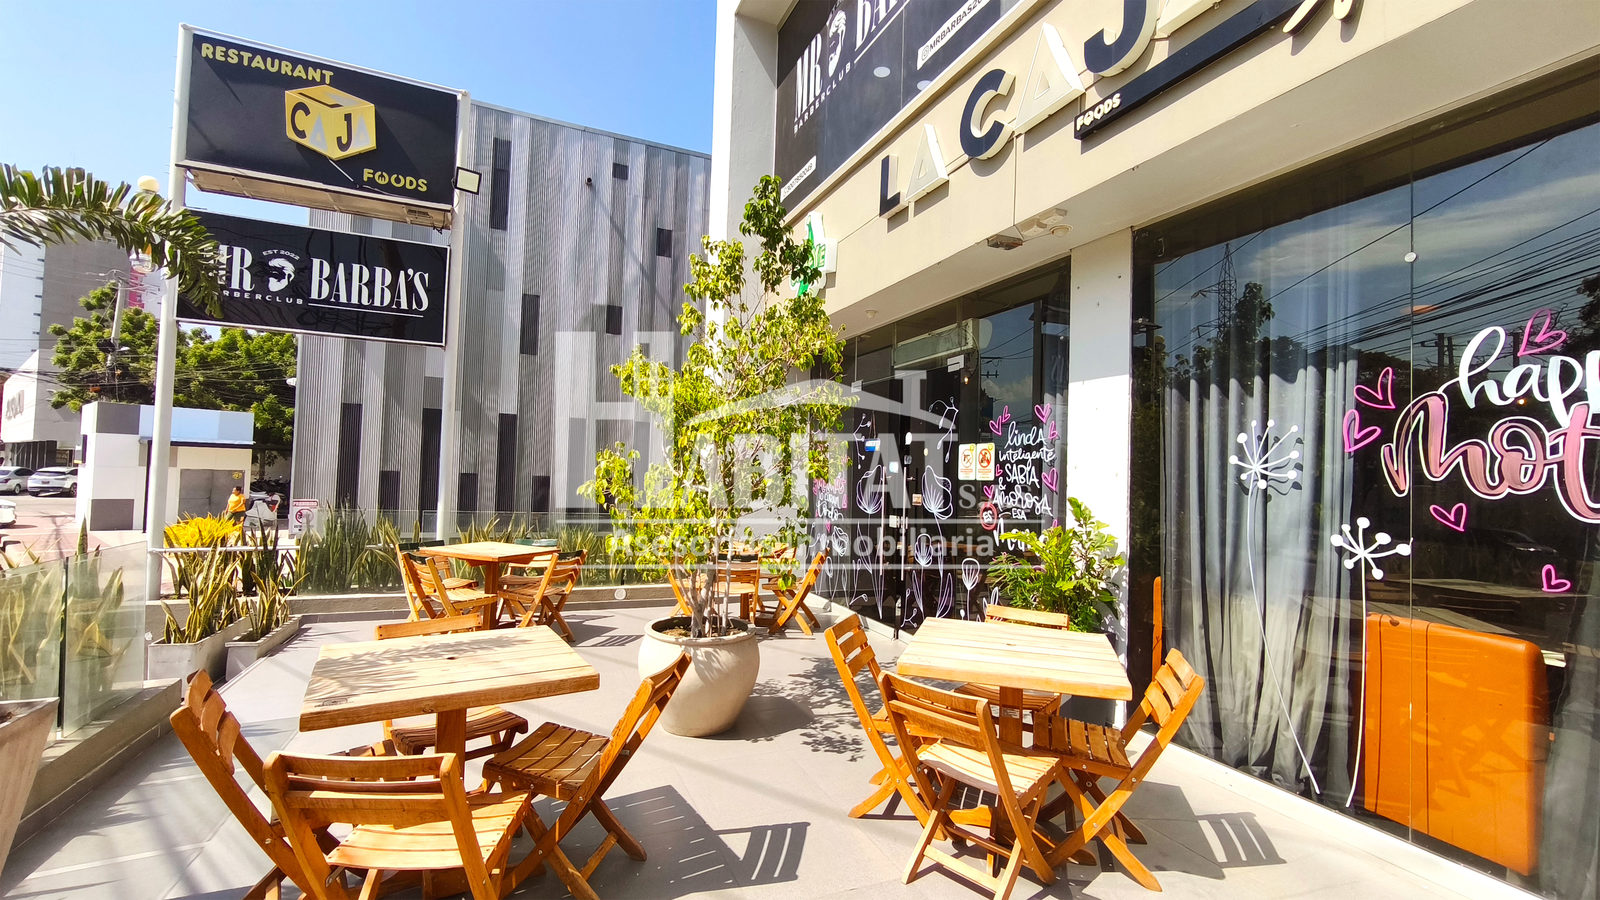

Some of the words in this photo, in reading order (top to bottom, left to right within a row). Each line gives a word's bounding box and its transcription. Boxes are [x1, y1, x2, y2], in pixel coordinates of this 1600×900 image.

[201, 42, 334, 85] RESTAURANT
[794, 33, 823, 123] MR
[794, 61, 851, 135] BARBERCLUB
[879, 124, 949, 218] LA
[959, 0, 1220, 161] CAJ
[1076, 93, 1121, 131] FOODS
[363, 168, 428, 192] FOODS
[212, 289, 303, 305] RBERCLUB
[308, 257, 429, 312] BARBA'S
